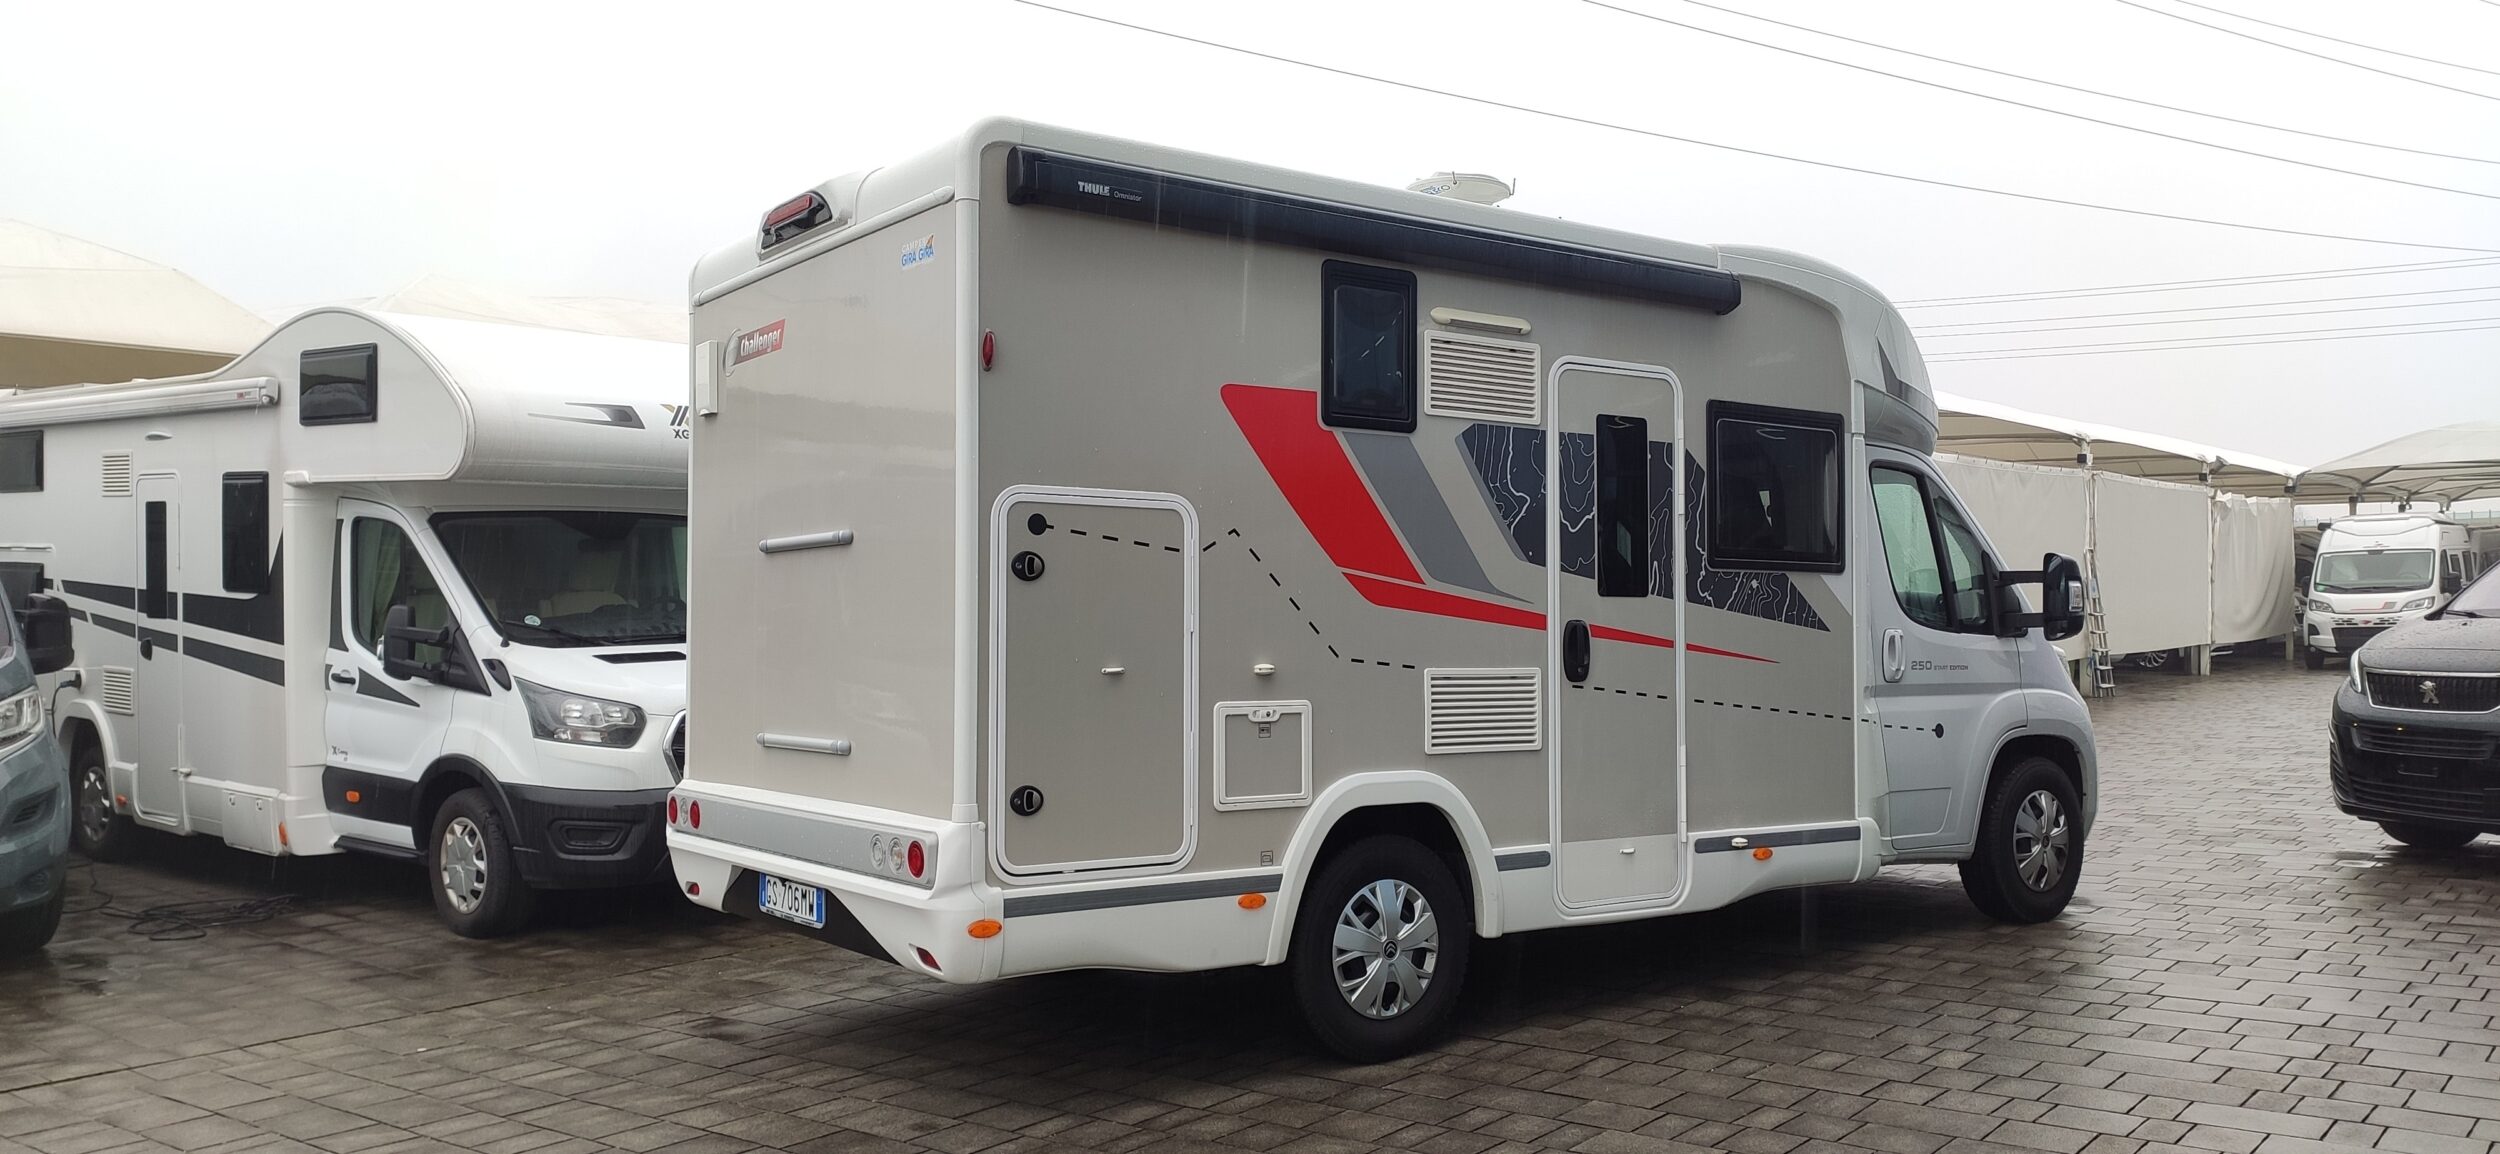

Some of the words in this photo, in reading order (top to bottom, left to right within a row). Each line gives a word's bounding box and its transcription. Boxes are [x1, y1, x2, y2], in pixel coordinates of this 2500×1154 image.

[1077, 181, 1110, 197] THULE
[901, 252, 917, 267] GIRA
[740, 328, 782, 357] Challenger
[1911, 660, 1932, 671] 250
[766, 879, 778, 907] GS
